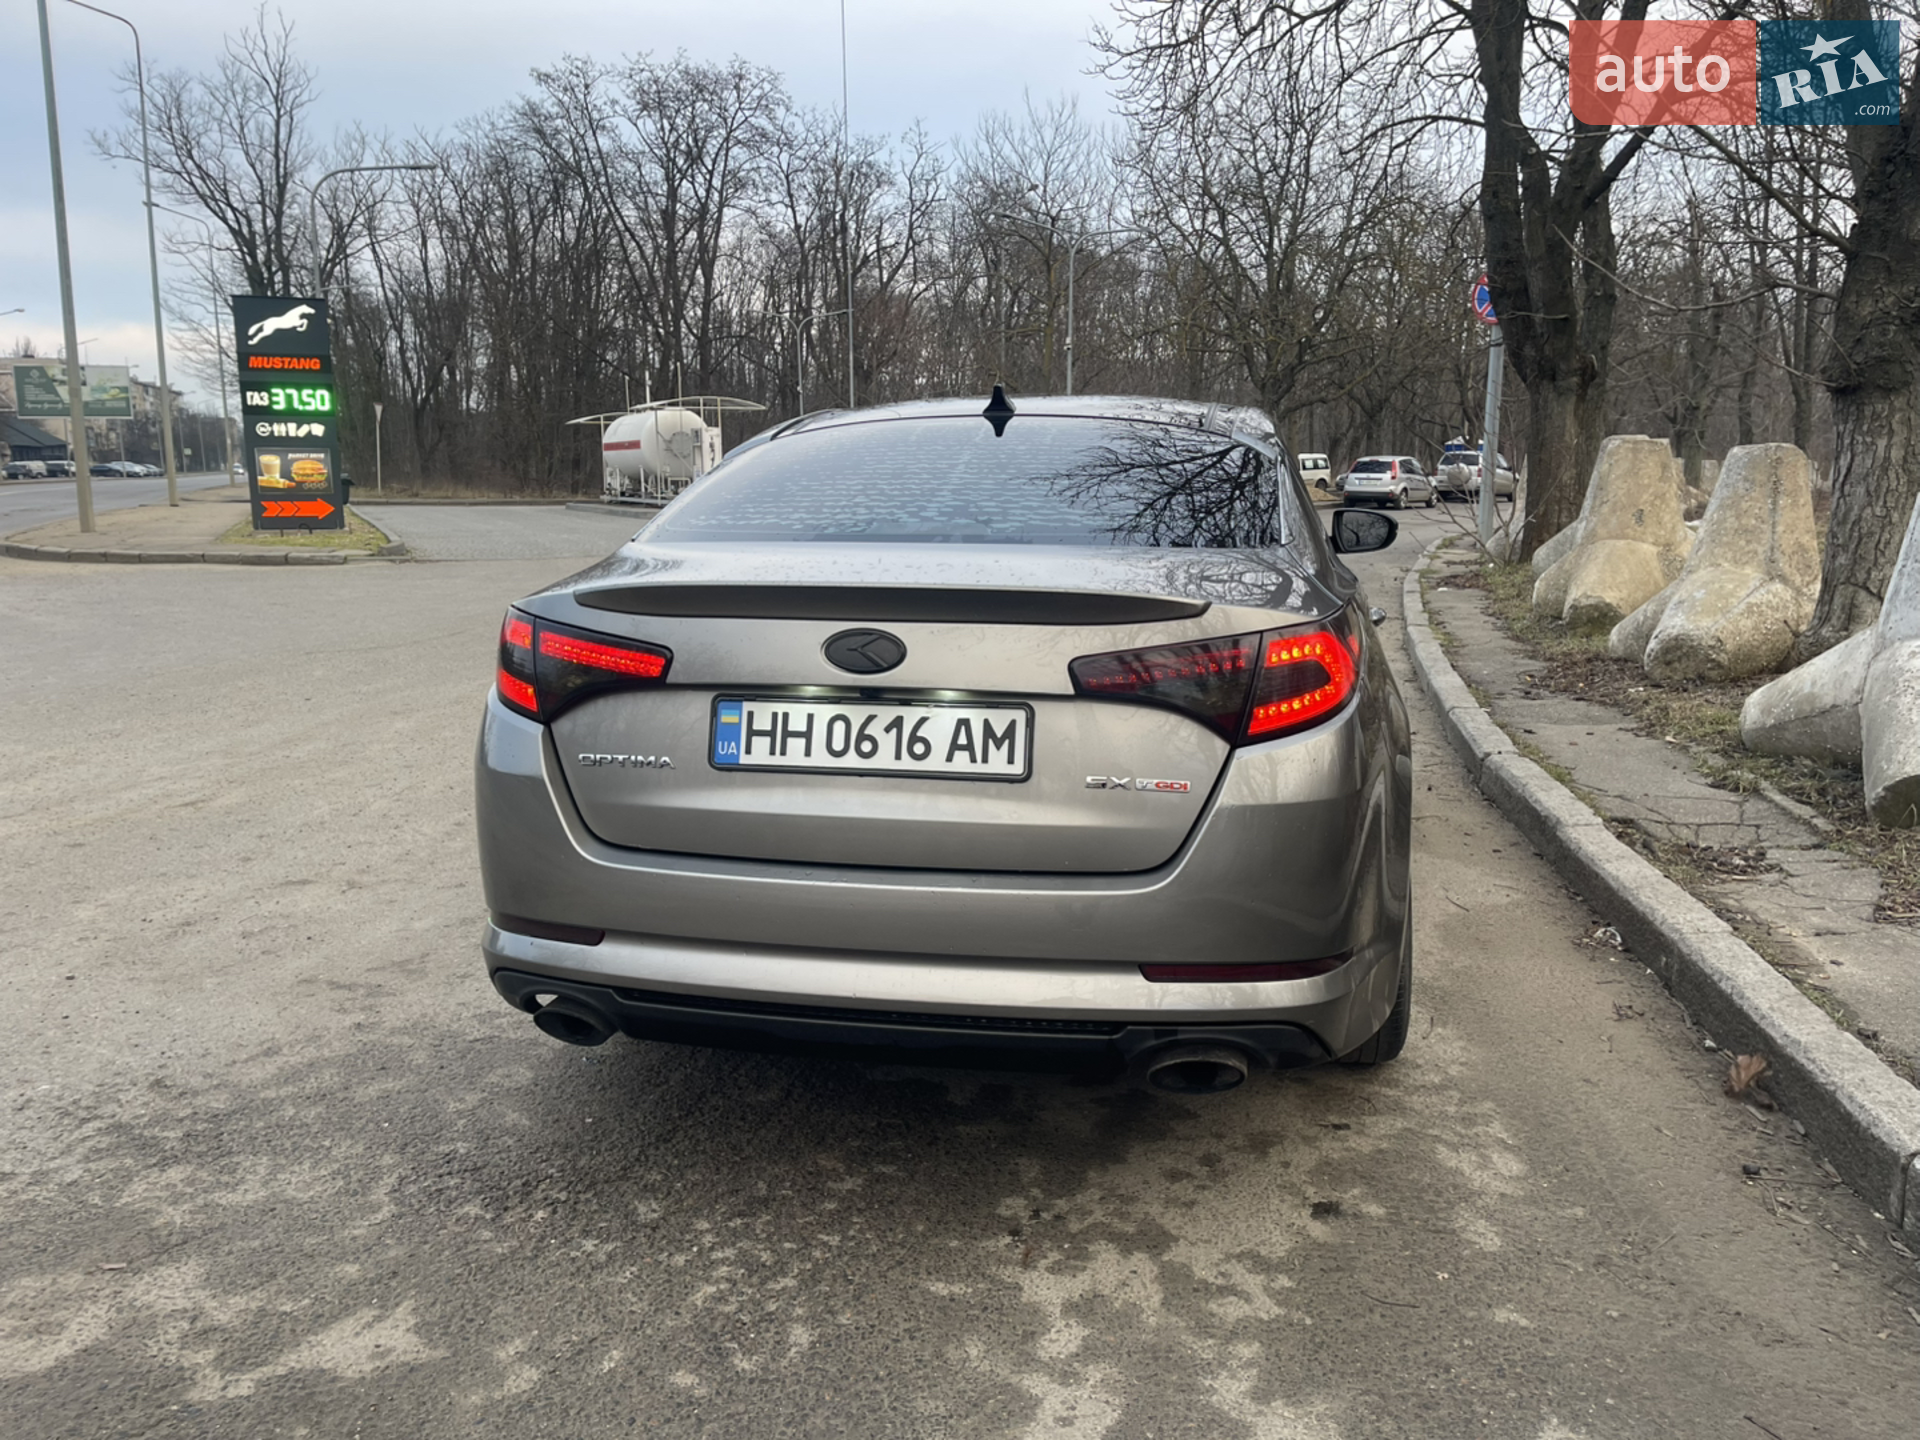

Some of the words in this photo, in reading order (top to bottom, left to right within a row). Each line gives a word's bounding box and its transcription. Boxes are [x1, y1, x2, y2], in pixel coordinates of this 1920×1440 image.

[248, 355, 321, 370] MUSTANG
[246, 391, 270, 406] ГАЗ
[271, 388, 332, 411] 37.50
[718, 741, 738, 756] UA
[744, 710, 815, 758] HH
[825, 713, 933, 762] 0616
[945, 717, 1018, 766] AM
[578, 752, 677, 770] OPTIMA
[1085, 775, 1132, 791] SX
